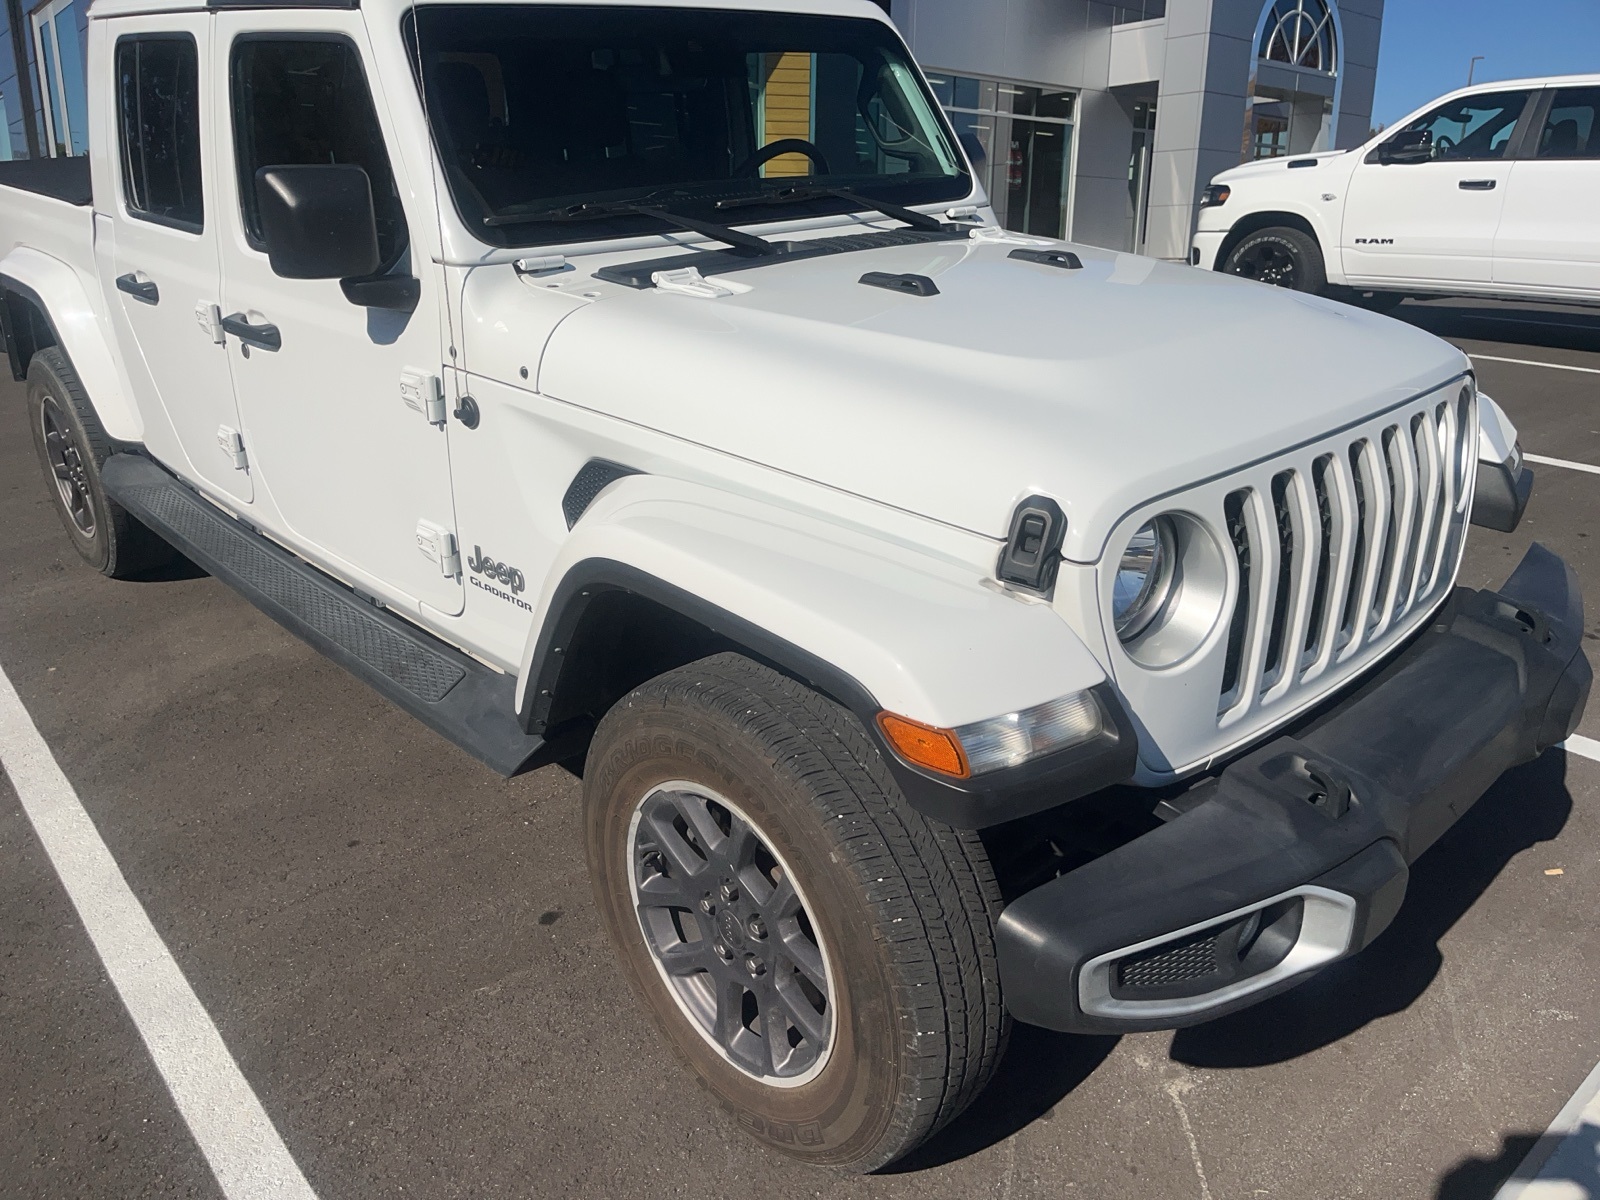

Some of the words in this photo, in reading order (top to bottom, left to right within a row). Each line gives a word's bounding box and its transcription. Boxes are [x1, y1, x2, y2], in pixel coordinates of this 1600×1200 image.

[467, 545, 525, 596] Jeep
[470, 576, 533, 613] GLADIATOR
[600, 733, 816, 878] BRIDGESTONE
